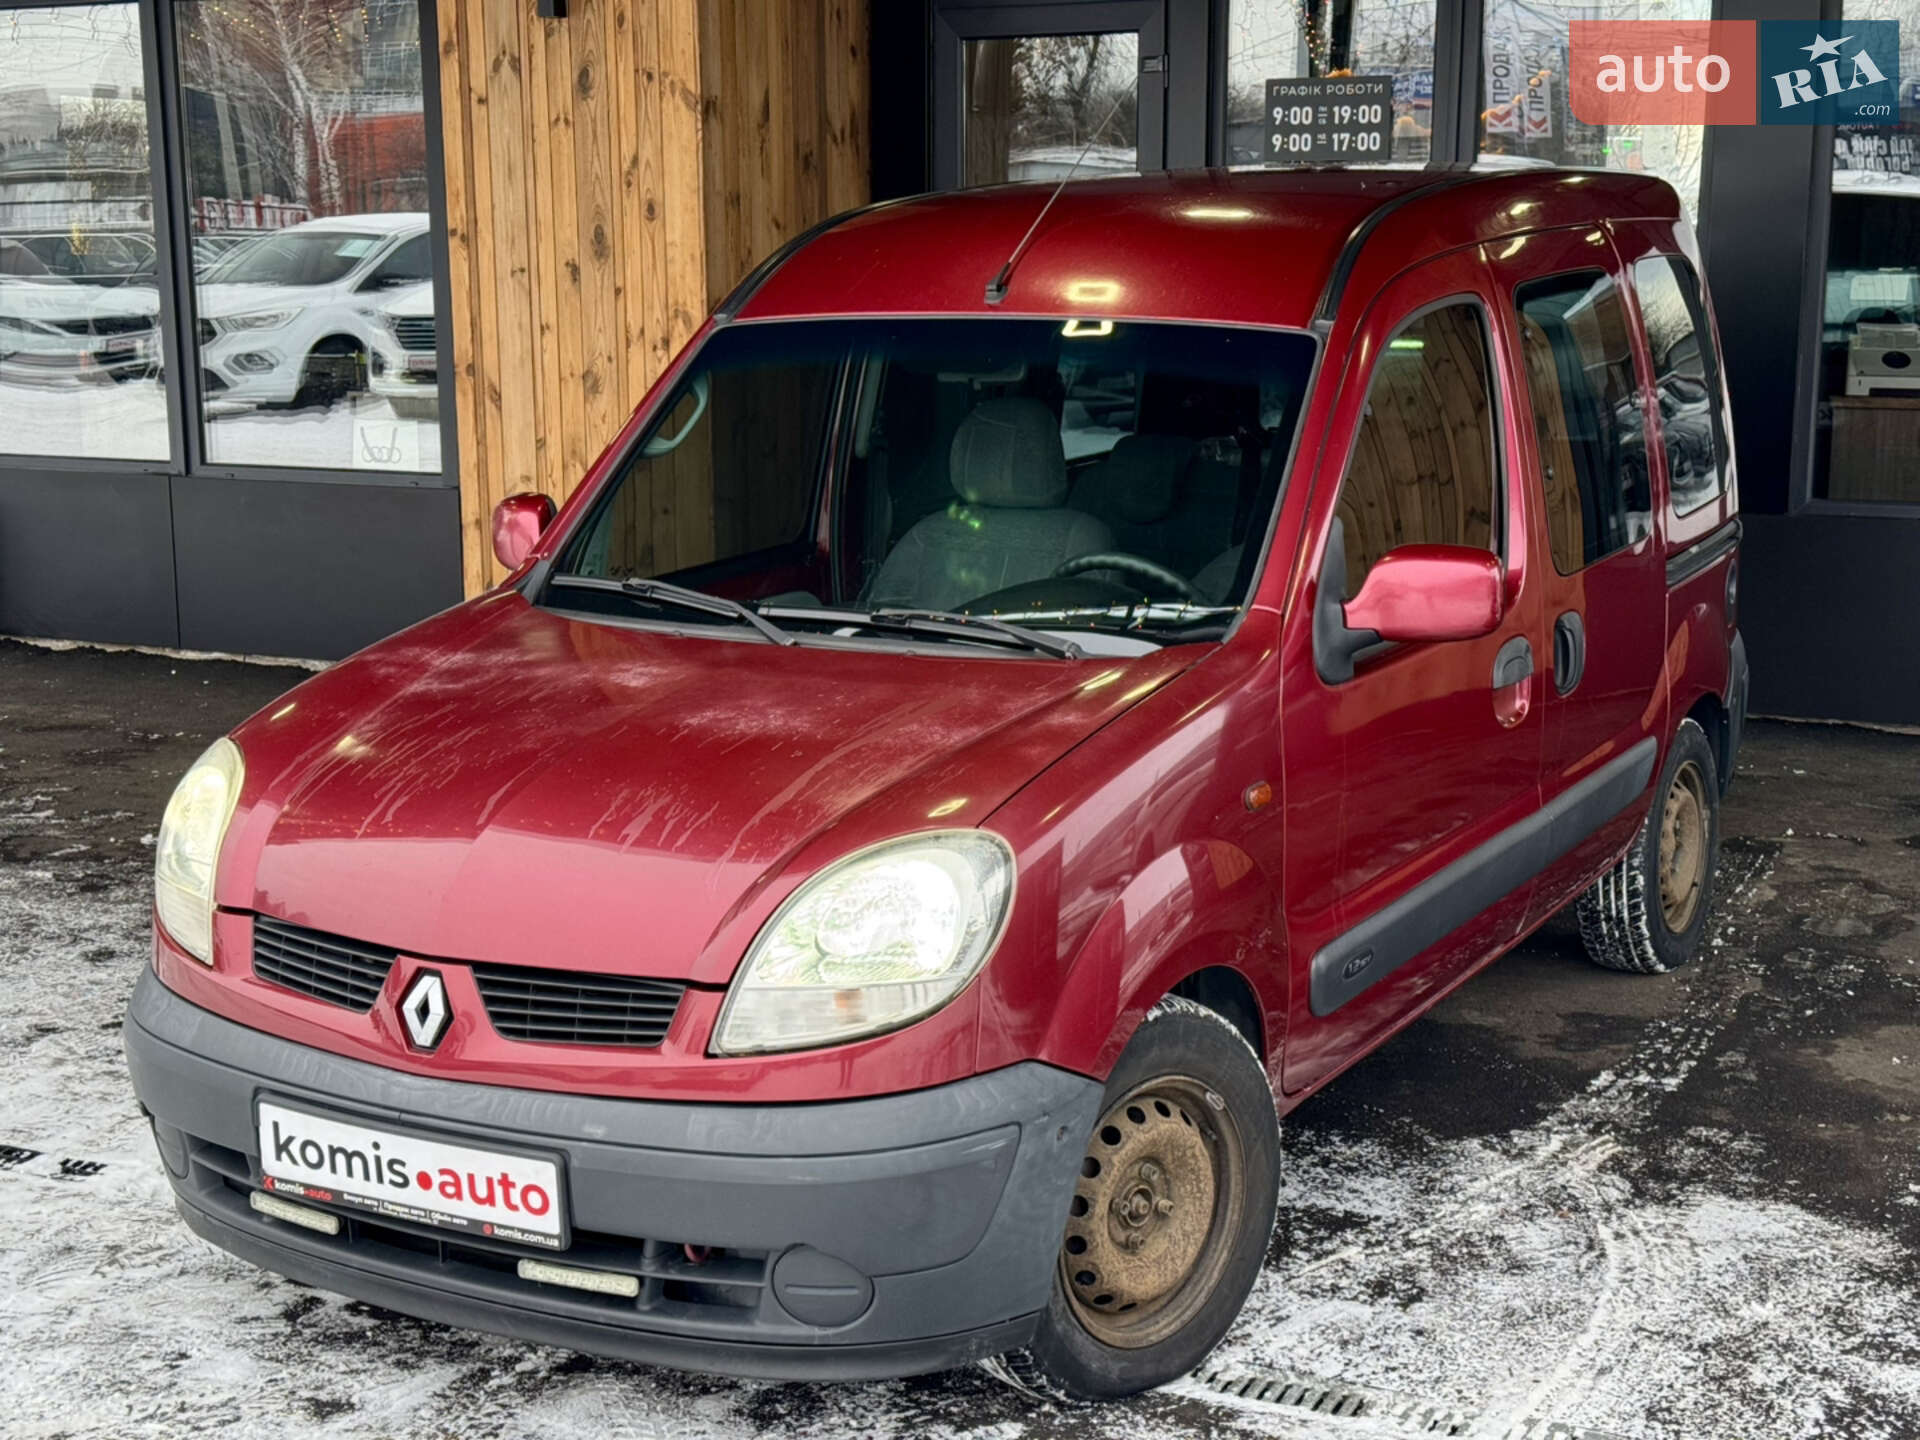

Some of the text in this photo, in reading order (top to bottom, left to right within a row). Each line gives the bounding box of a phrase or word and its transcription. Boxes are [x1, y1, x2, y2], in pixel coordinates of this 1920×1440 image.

[1272, 83, 1384, 96] ГРАФІК РОБОТИ
[1272, 105, 1382, 125] 9:00 19:00
[1271, 132, 1381, 152] 9:00 17:00
